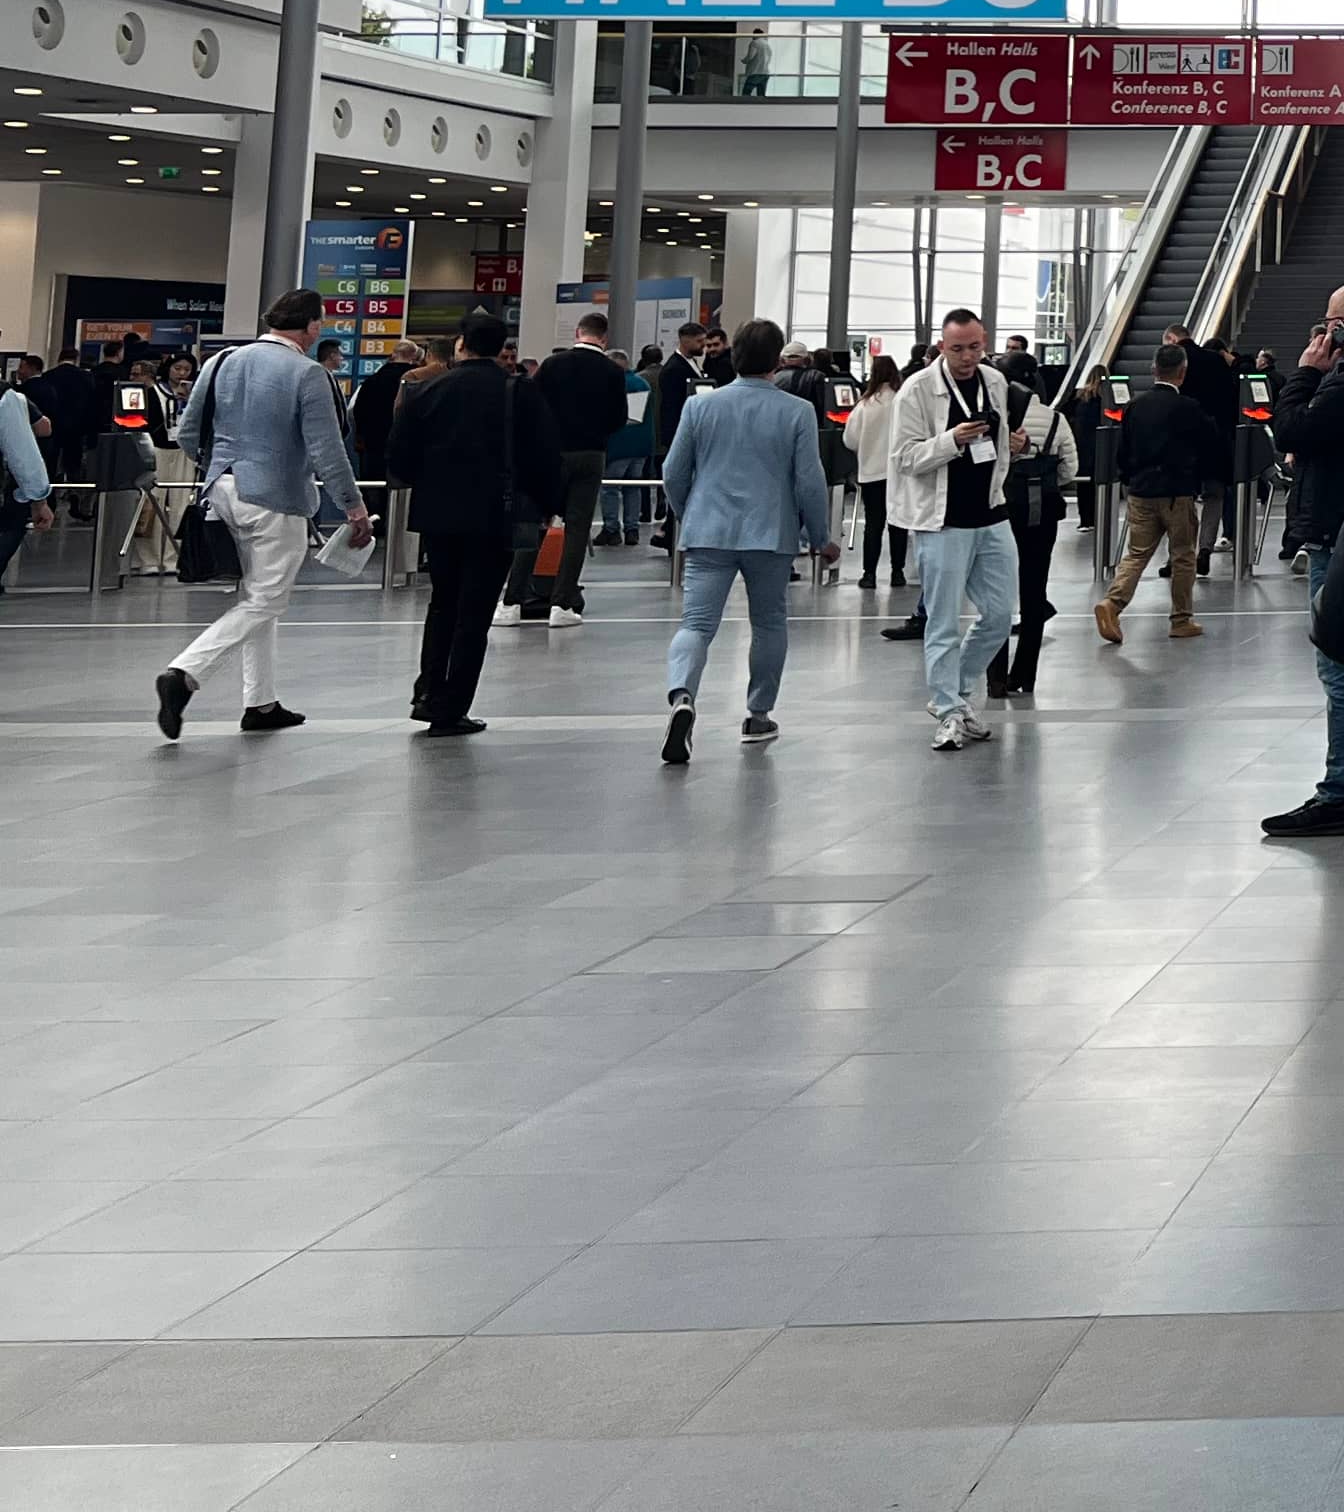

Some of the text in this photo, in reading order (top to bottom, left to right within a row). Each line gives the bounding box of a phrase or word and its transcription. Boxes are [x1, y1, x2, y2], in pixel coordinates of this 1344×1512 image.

[947, 42, 1038, 56] Hallen Halls
[944, 69, 1036, 121] B,C
[1112, 82, 1224, 97] Konferenz B, C
[1261, 85, 1341, 97] Konferenz A
[1111, 100, 1227, 116] Conference B, C
[1261, 103, 1330, 114] Conference
[978, 136, 1043, 146] Hallen Halls
[976, 155, 1042, 189] B,C
[338, 281, 389, 293] C6 B6
[336, 301, 388, 313] C5 B5
[334, 321, 386, 332] C4 B4
[366, 341, 385, 353] B3
